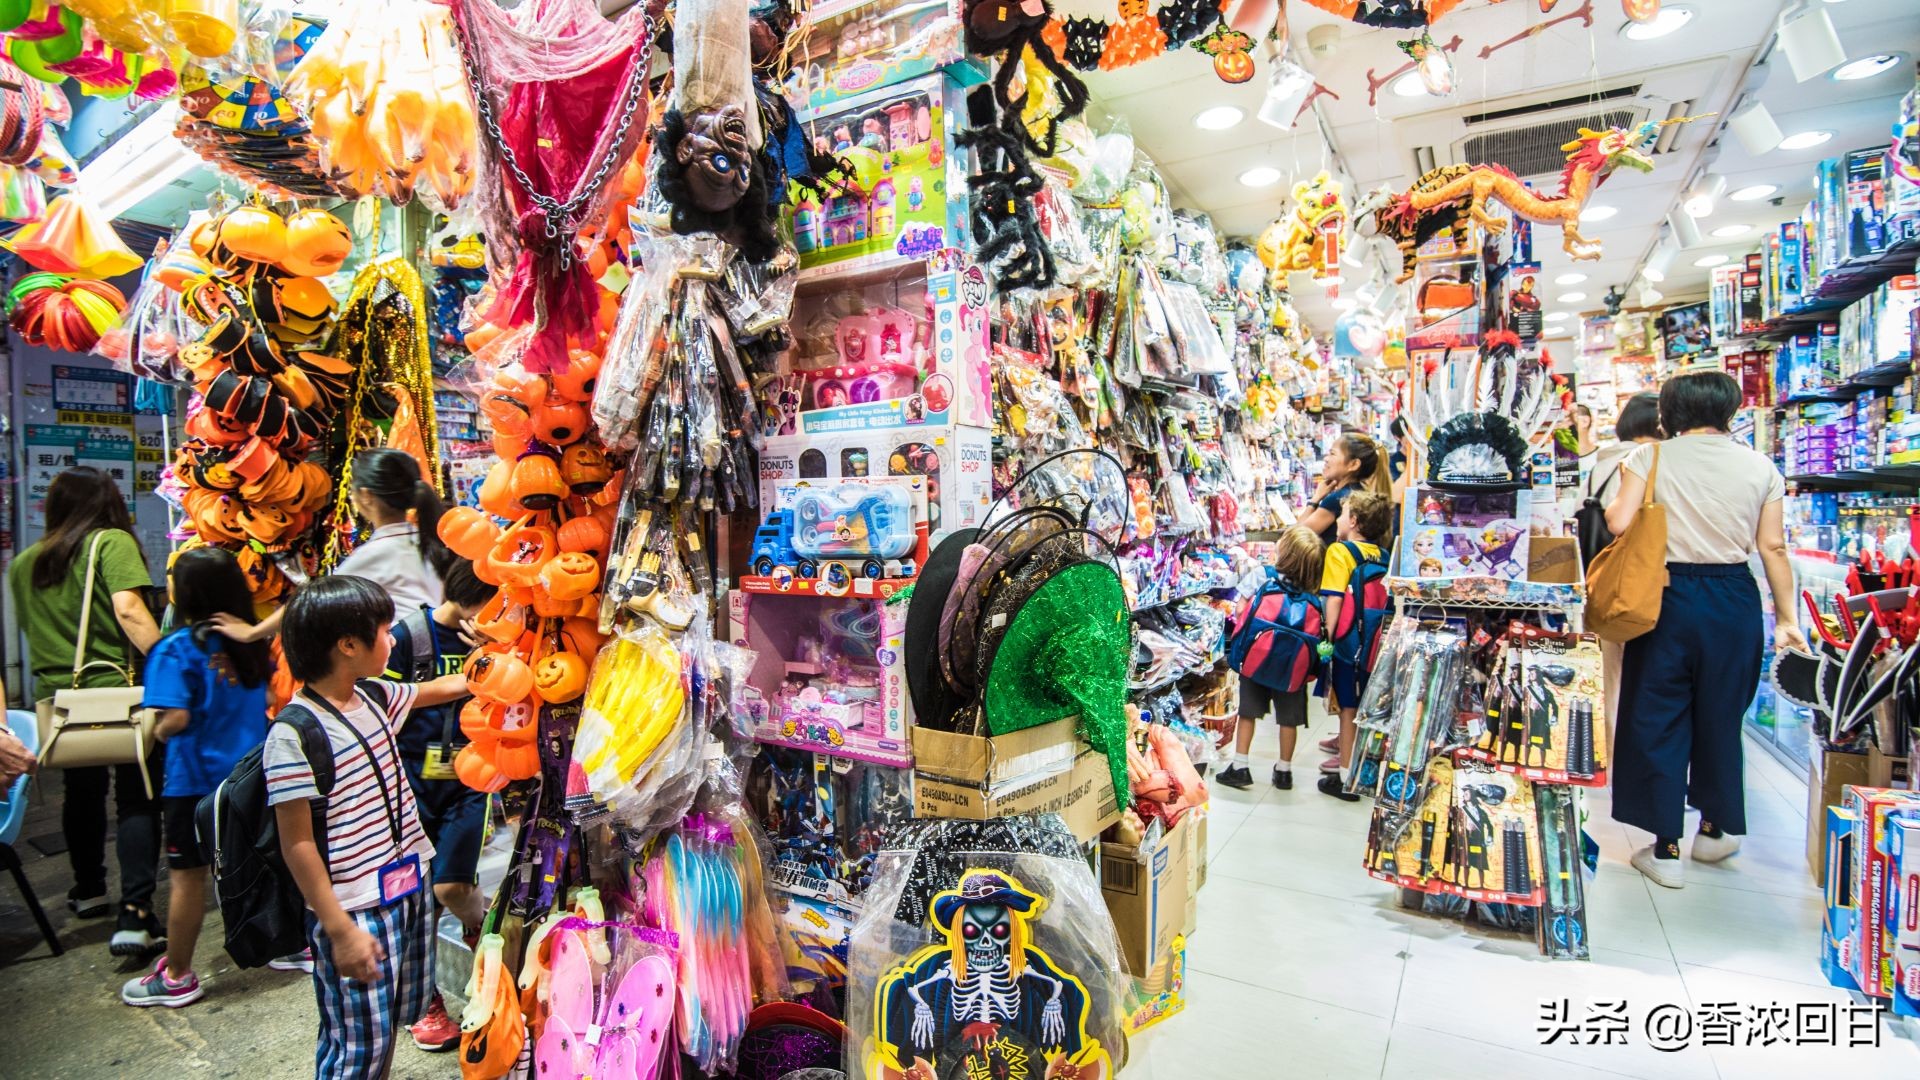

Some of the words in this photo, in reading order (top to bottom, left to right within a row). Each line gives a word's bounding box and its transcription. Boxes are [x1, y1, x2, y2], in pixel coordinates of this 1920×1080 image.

[253, 112, 268, 120] 10
[961, 449, 987, 461] DONUTS
[760, 460, 793, 470] DONUTS
[961, 461, 979, 472] SHOP
[760, 470, 783, 480] SHOP
[996, 775, 1059, 808] E0490AS04-LCN
[927, 804, 938, 812] Pcs
[1004, 806, 1015, 816] Pcs
[1909, 967, 1918, 995] THOMAS
